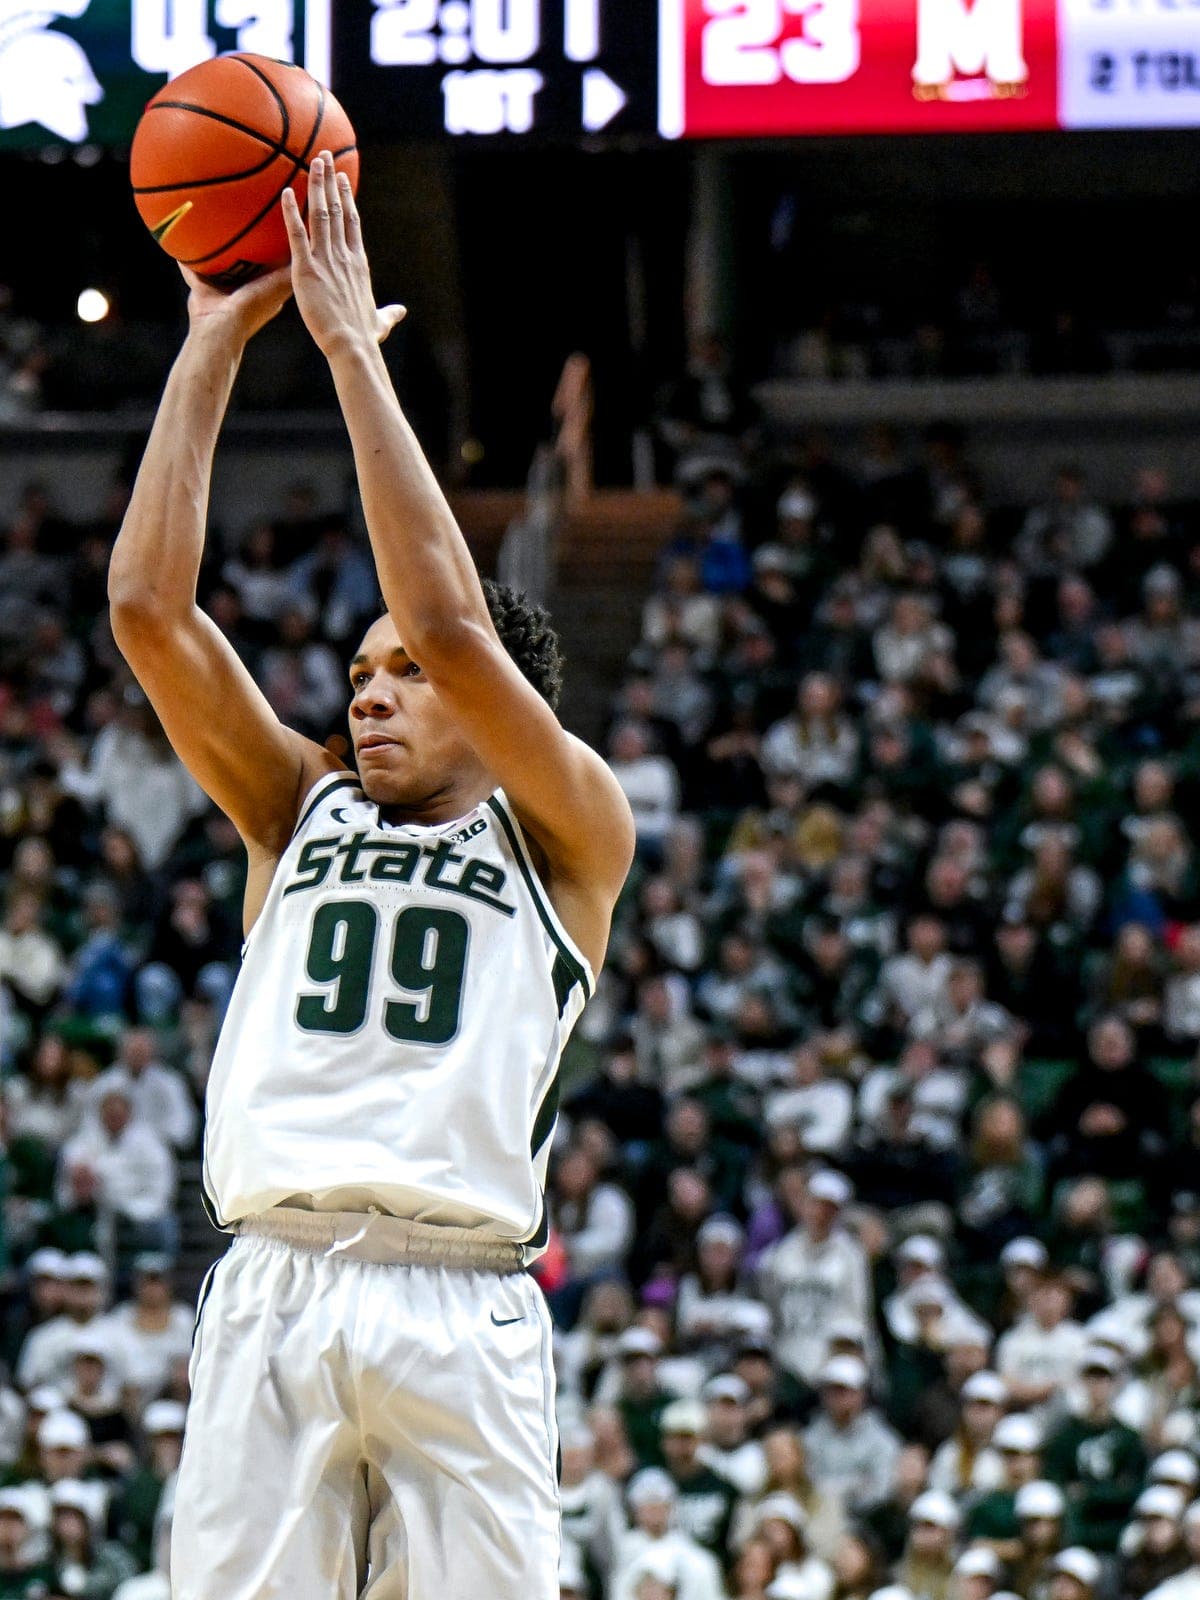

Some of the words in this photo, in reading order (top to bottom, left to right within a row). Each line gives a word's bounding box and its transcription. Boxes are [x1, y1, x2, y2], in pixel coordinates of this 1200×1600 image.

[371, 0, 600, 65] 2:01
[701, 0, 860, 86] 23
[441, 67, 544, 135] 1ST
[283, 831, 517, 919] State
[294, 898, 472, 1049] 99
